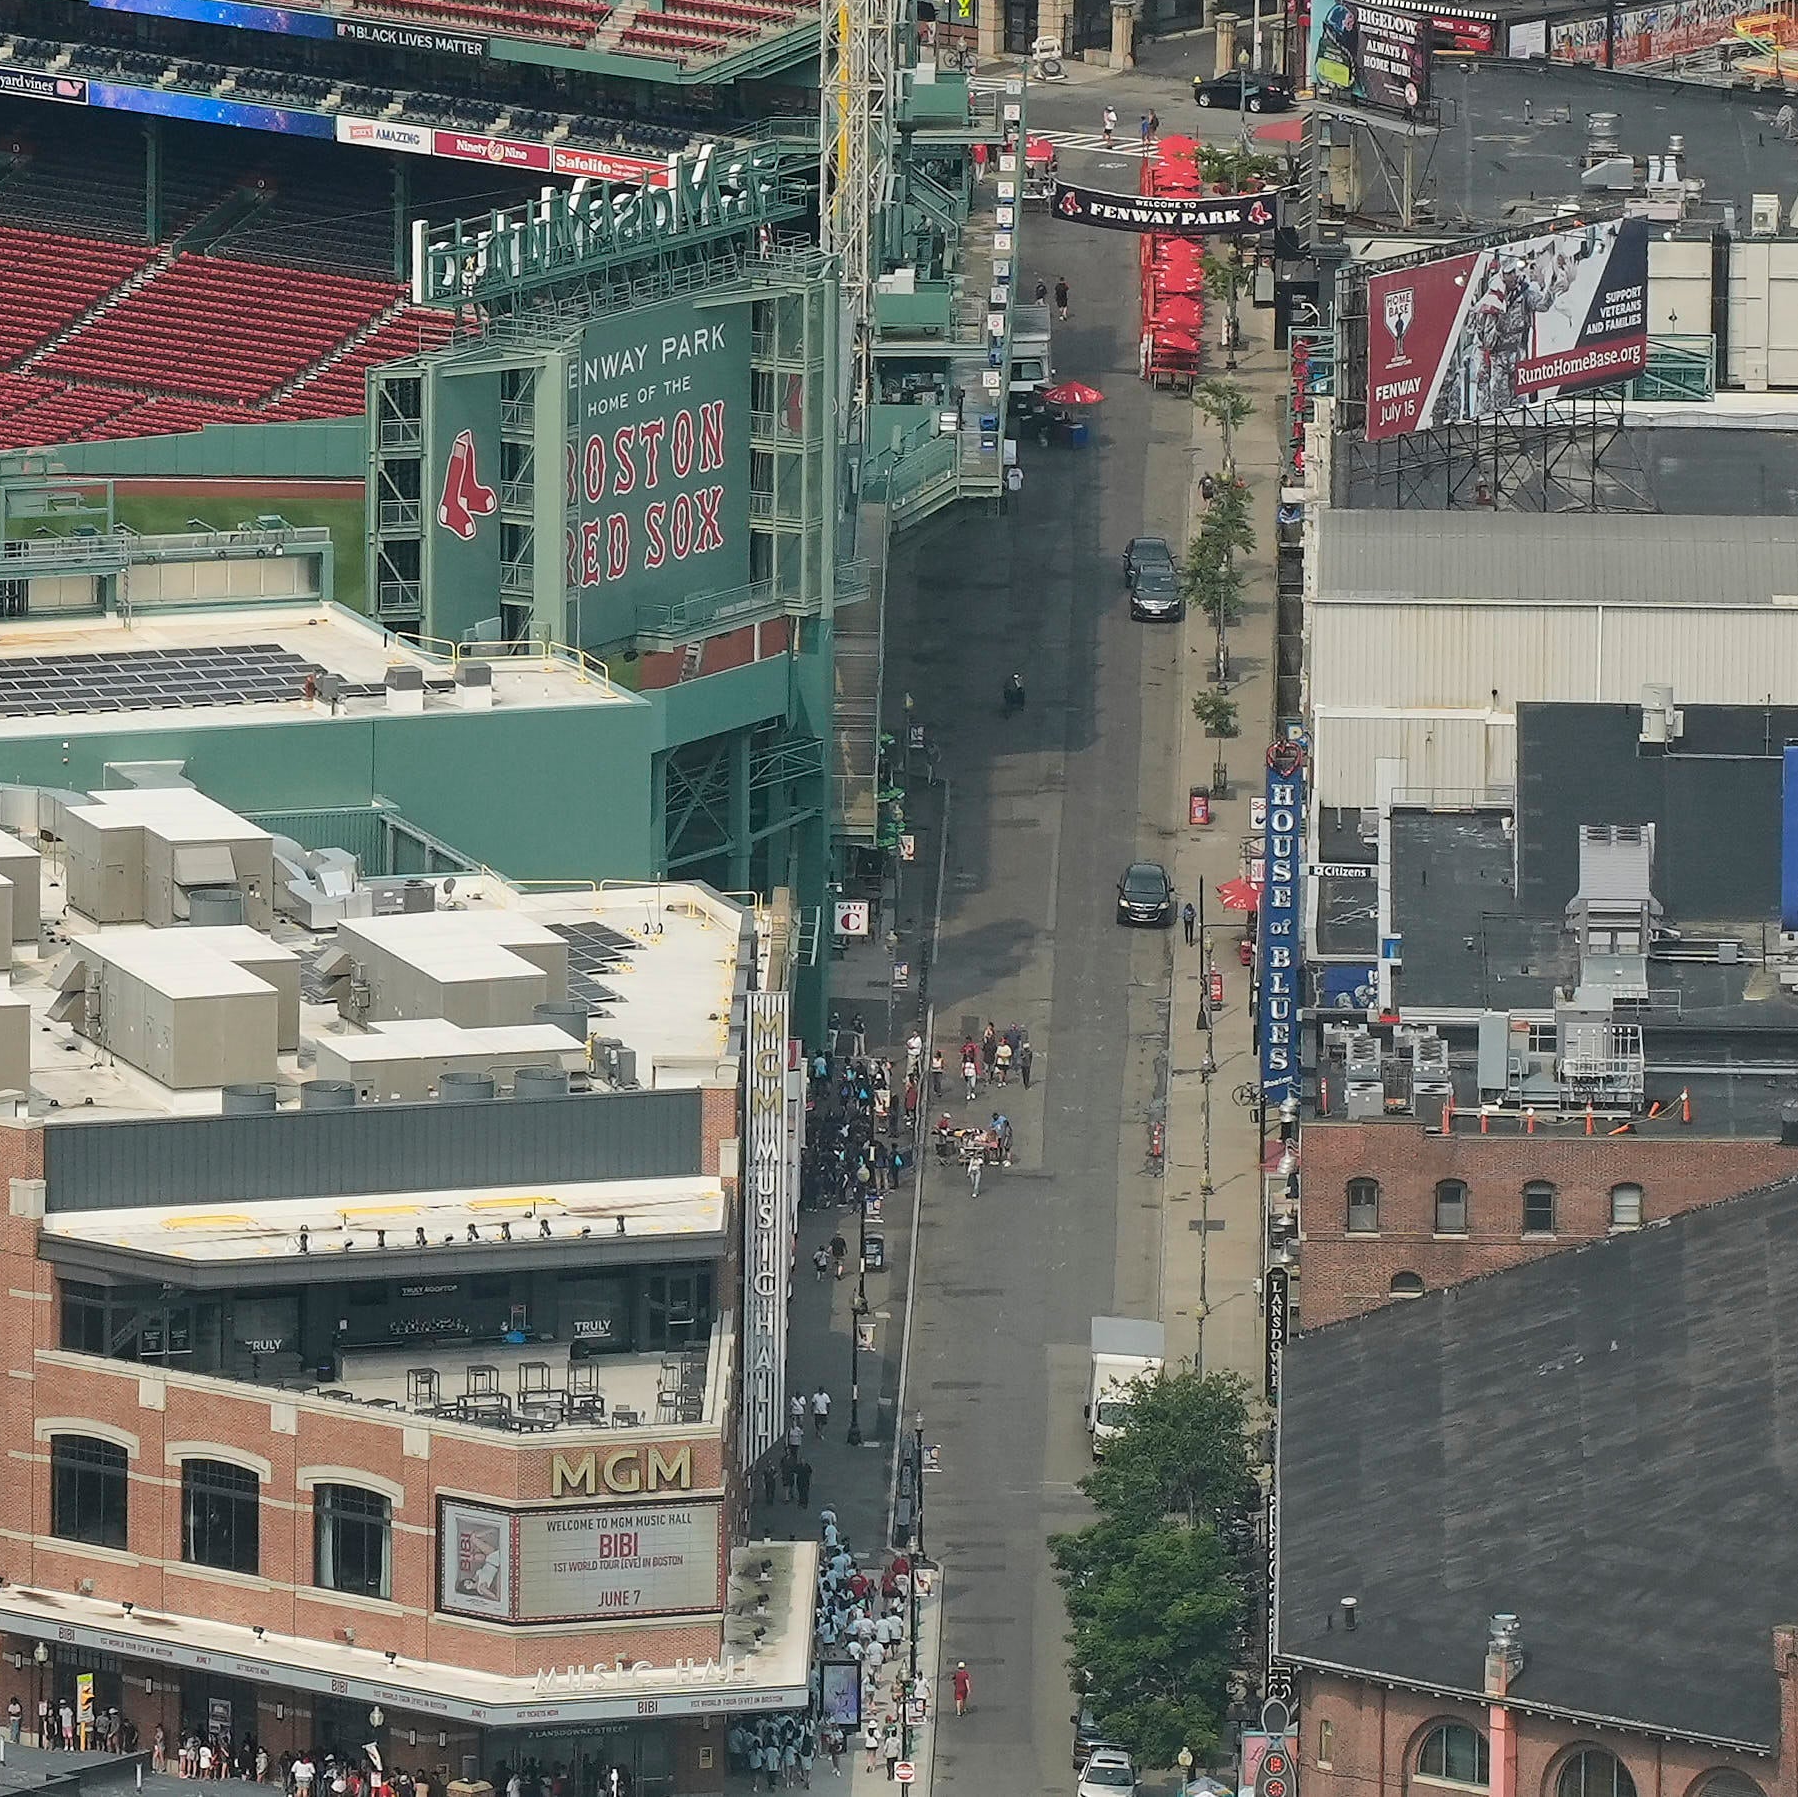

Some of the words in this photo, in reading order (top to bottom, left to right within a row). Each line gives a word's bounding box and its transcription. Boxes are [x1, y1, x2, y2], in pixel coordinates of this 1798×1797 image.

[1357, 7, 1418, 36] BIGELOW
[357, 26, 397, 44] BLACK
[399, 32, 433, 49] LIVES
[435, 37, 483, 56] MATTER
[1366, 40, 1400, 58] ALWAYS
[1401, 49, 1408, 61] A
[1363, 55, 1389, 72] HOME
[24, 77, 54, 92] vines
[456, 139, 487, 156] Ninety
[505, 146, 527, 161] Nine
[556, 155, 612, 174] Safelite
[1090, 202, 1177, 225] FENWAY
[1181, 209, 1241, 226] PARK
[1135, 199, 1180, 209] WELCOME
[1183, 201, 1197, 209] TO
[1386, 292, 1412, 304] HOME
[1605, 285, 1642, 304] SUPPORT
[1388, 303, 1409, 316] BASE
[1599, 300, 1642, 319] VETERANS
[1586, 324, 1604, 336] AND
[1605, 314, 1642, 332] FAMILIES
[568, 344, 649, 390] ENWAY
[661, 323, 726, 364] PARK
[1517, 345, 1641, 386] RuntoHomeBase.org
[587, 392, 629, 417] HOME
[637, 385, 657, 403] OF
[663, 375, 692, 396] THE
[1375, 376, 1422, 402] FENWAY
[1379, 404, 1402, 426] July
[1404, 400, 1415, 416] 15
[644, 485, 724, 570] SOX
[1270, 784, 1294, 908] HOUSE
[1324, 865, 1367, 878] Citizens
[841, 913, 860, 931] C
[1270, 919, 1291, 935] of
[1268, 946, 1292, 1071] BLUES
[752, 1011, 783, 1116] MGM
[754, 1138, 781, 1296] MUSIC
[574, 1320, 611, 1332] TRULY
[552, 1445, 691, 1498] MGM
[547, 1516, 593, 1532] WELCOME
[596, 1517, 607, 1529] TO
[610, 1515, 634, 1528] MGM
[636, 1514, 666, 1526] MUSIC
[668, 1513, 692, 1525] HALL
[460, 1533, 472, 1572] BIBI
[599, 1532, 639, 1559] BIBI
[553, 1562, 567, 1572] 1ST
[569, 1559, 597, 1571] WORLD
[599, 1559, 619, 1570] TOUR
[642, 1558, 651, 1568] IN
[652, 1555, 684, 1568] BOSTON
[598, 1591, 630, 1608] JUNE
[633, 1590, 641, 1605] 7
[58, 1627, 75, 1641] BIBI
[331, 1679, 348, 1694] BIBI
[534, 1660, 653, 1694] MUSIC
[637, 1701, 659, 1715] BIBI
